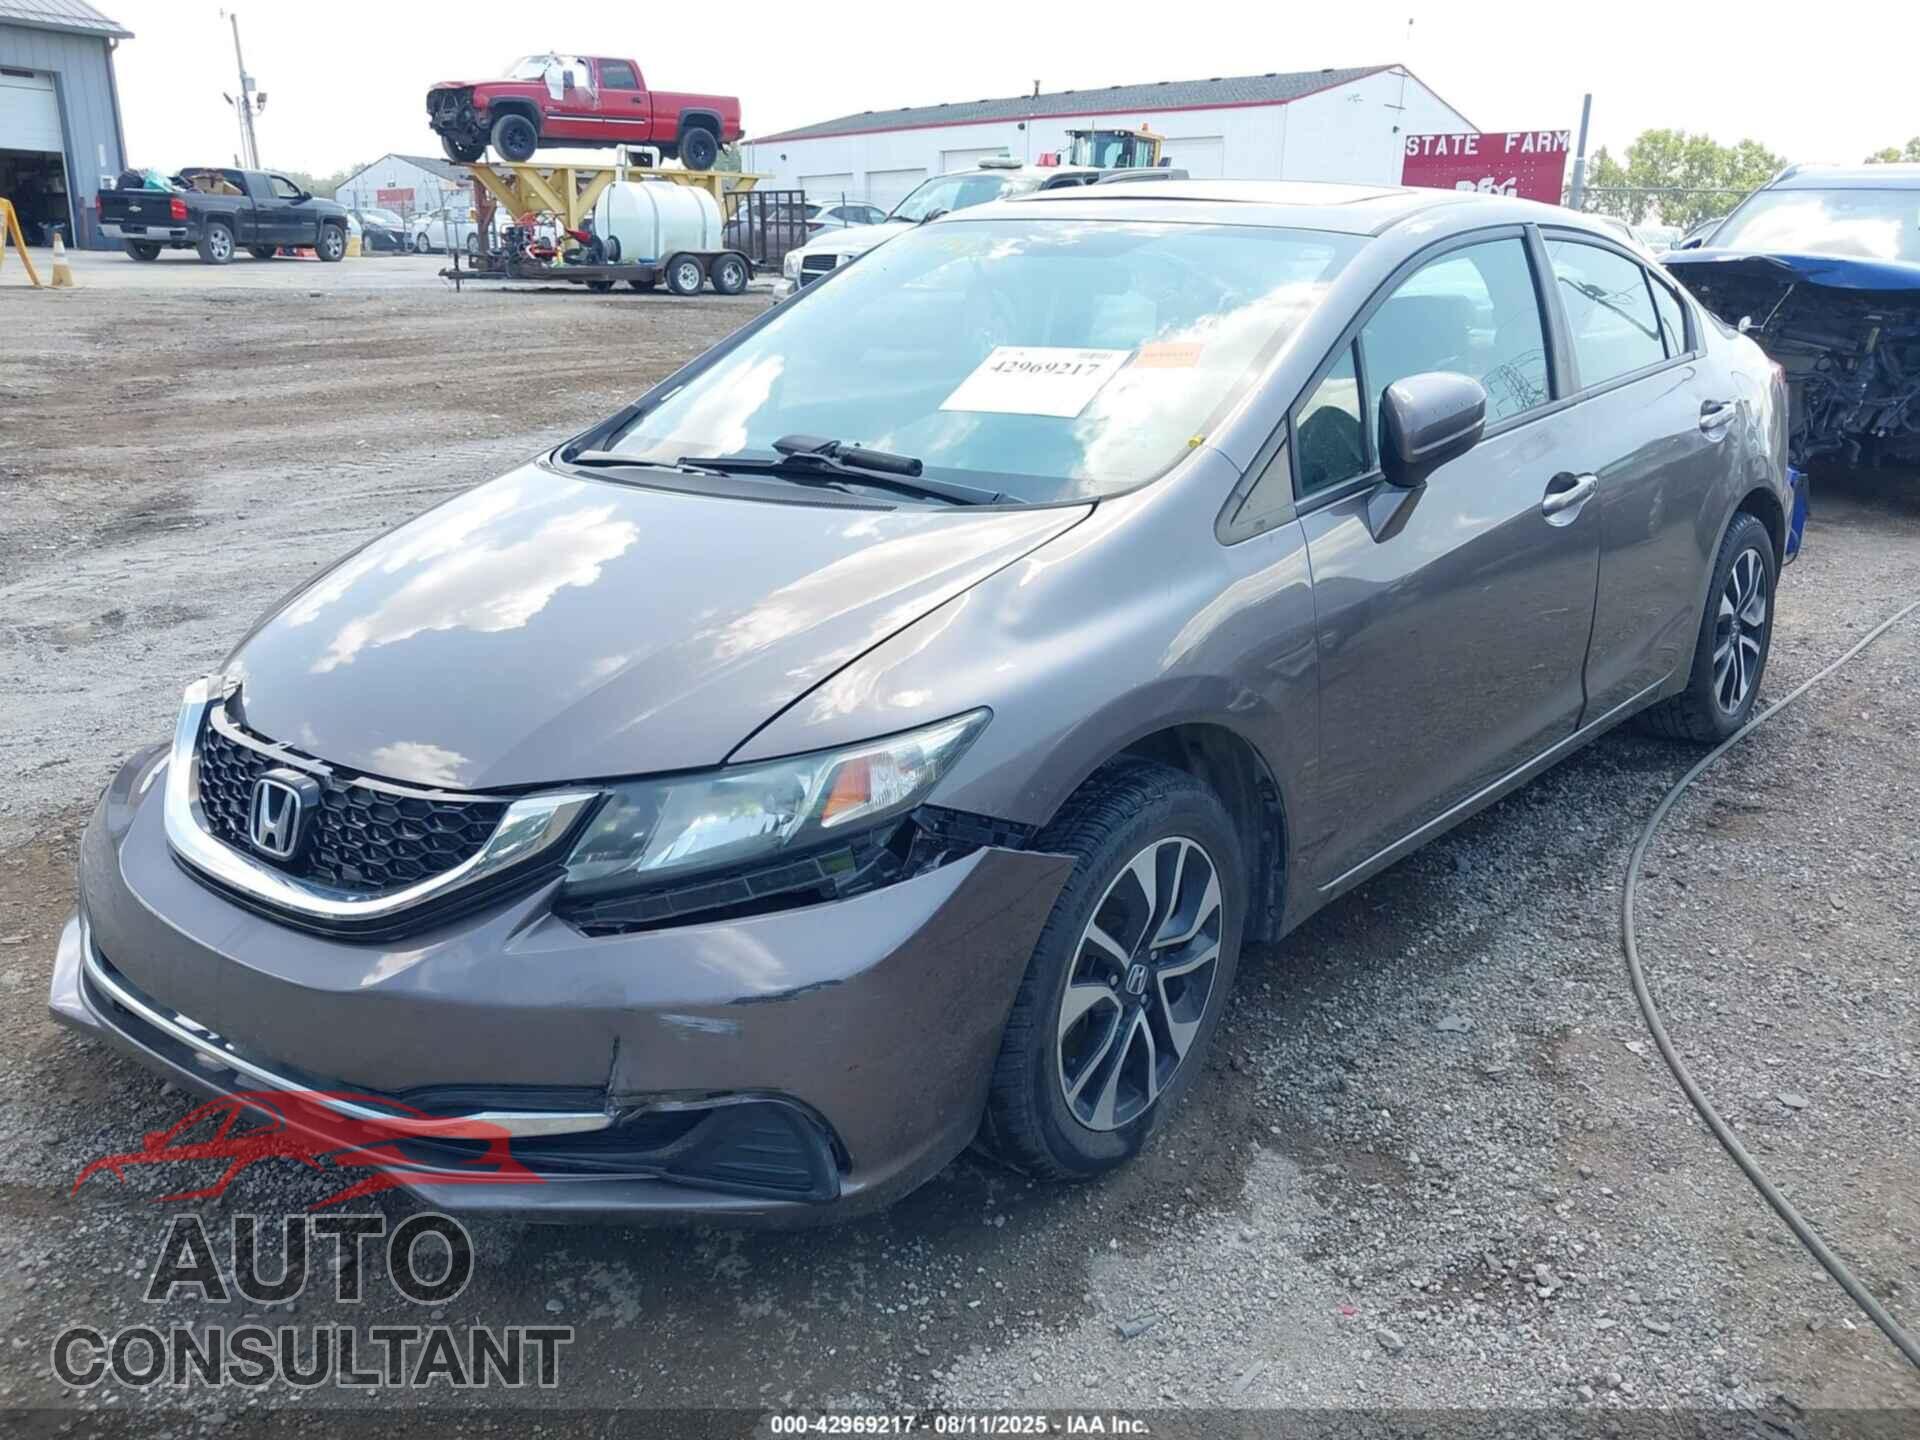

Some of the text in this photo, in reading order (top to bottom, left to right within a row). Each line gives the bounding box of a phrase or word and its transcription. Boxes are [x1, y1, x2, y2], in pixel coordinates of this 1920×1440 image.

[1406, 131, 1569, 156] STATE FARM
[991, 360, 1101, 375] 42969217
